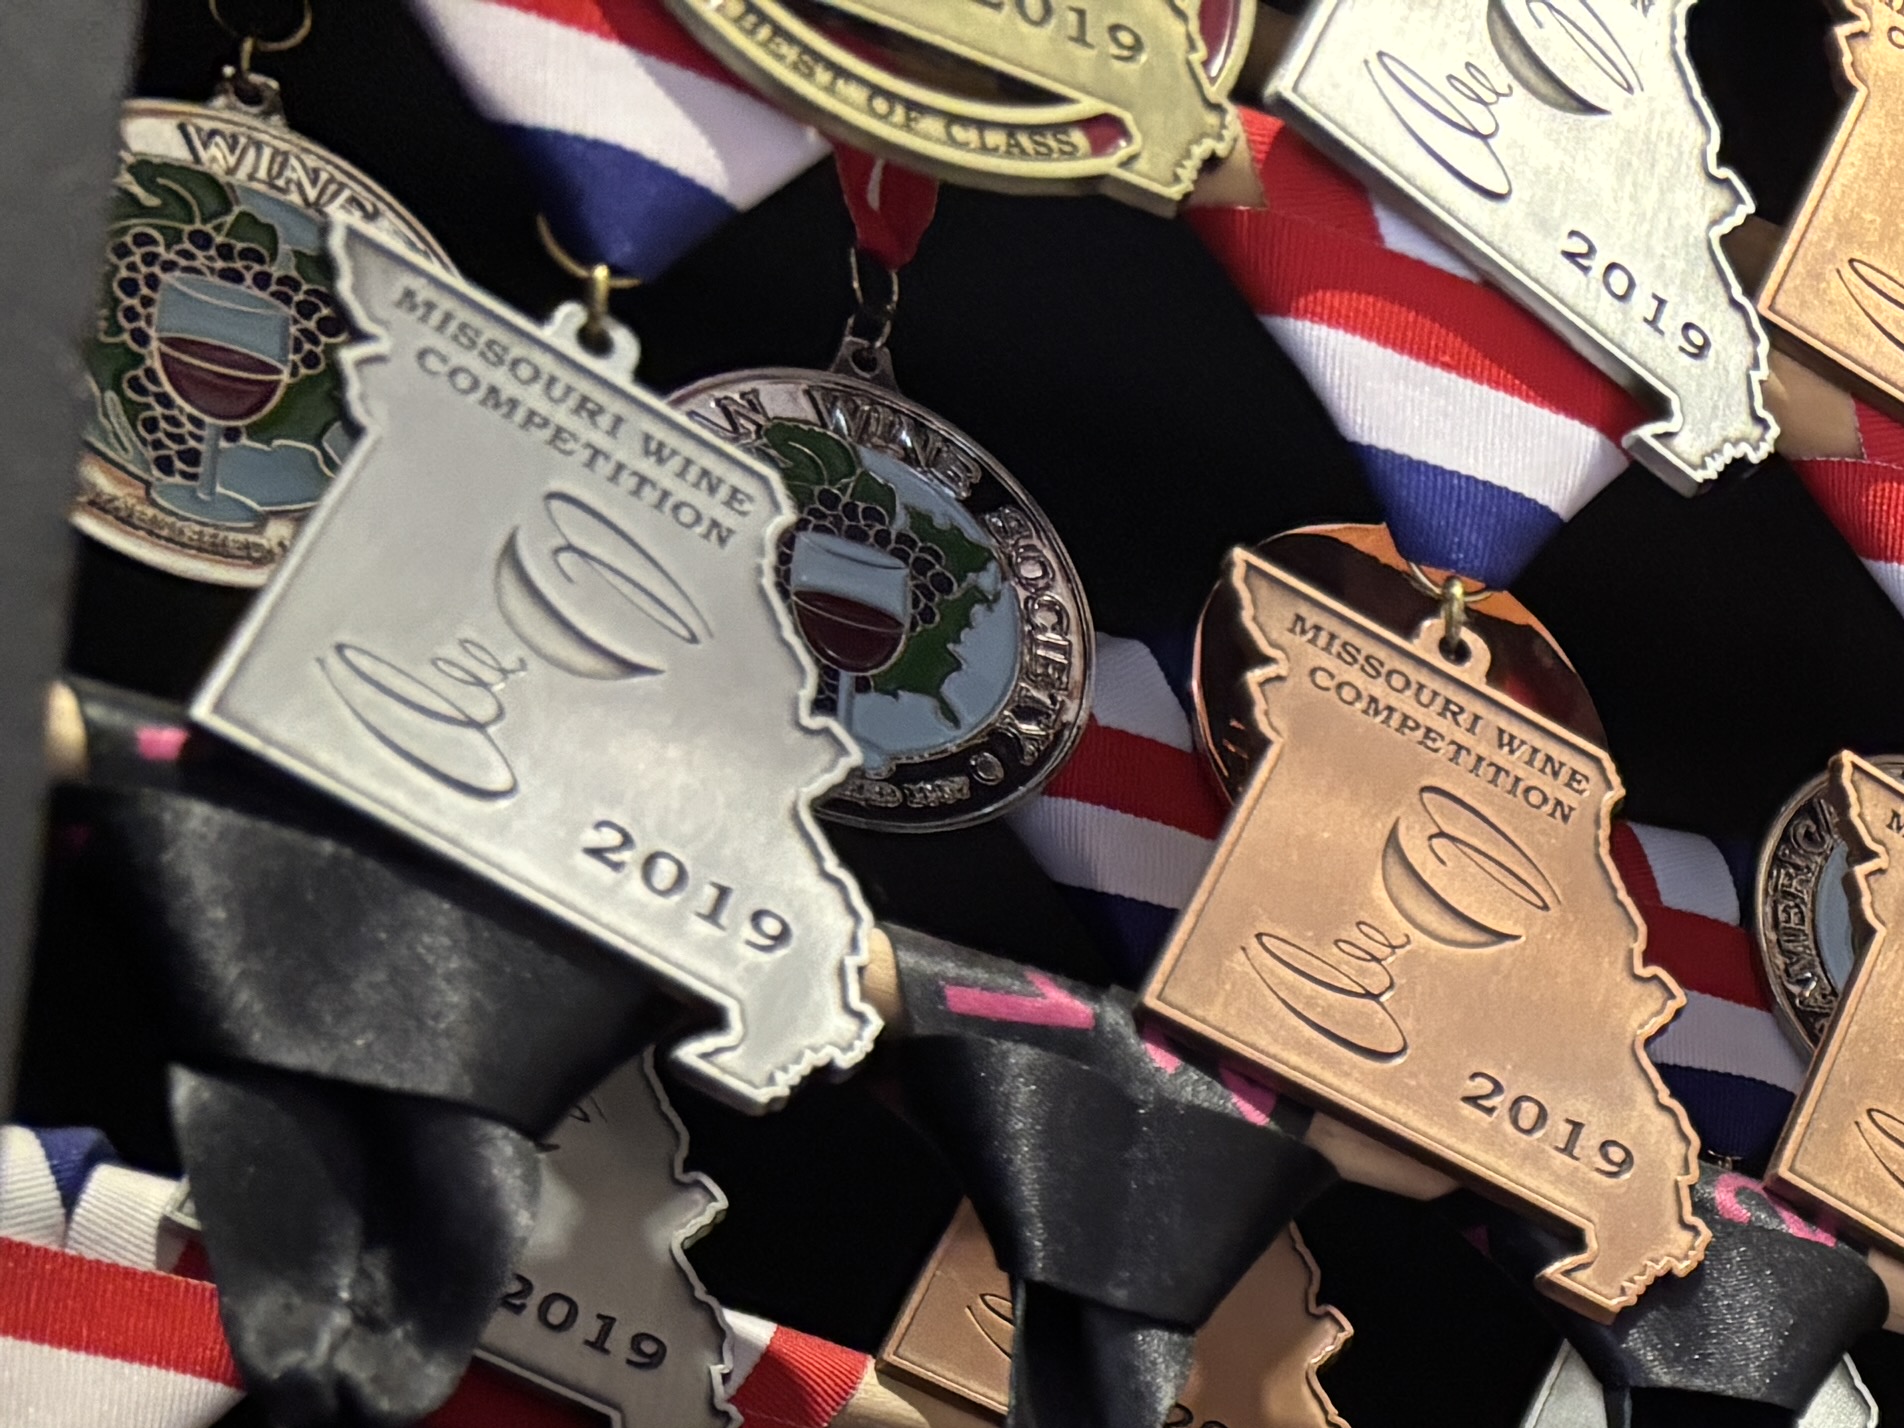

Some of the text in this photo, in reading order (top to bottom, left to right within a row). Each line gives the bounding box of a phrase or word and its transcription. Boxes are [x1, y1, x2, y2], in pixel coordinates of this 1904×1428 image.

[985, 0, 1145, 63] 019
[1559, 230, 1714, 361] 2019
[393, 286, 753, 517] MISSOURI WINE
[415, 346, 737, 550] COMPETITION
[1288, 612, 1591, 796] MISSOURI WINE
[1309, 666, 1578, 825] COMPETITION
[580, 819, 794, 952] 2019
[1461, 1072, 1637, 1179] 2019
